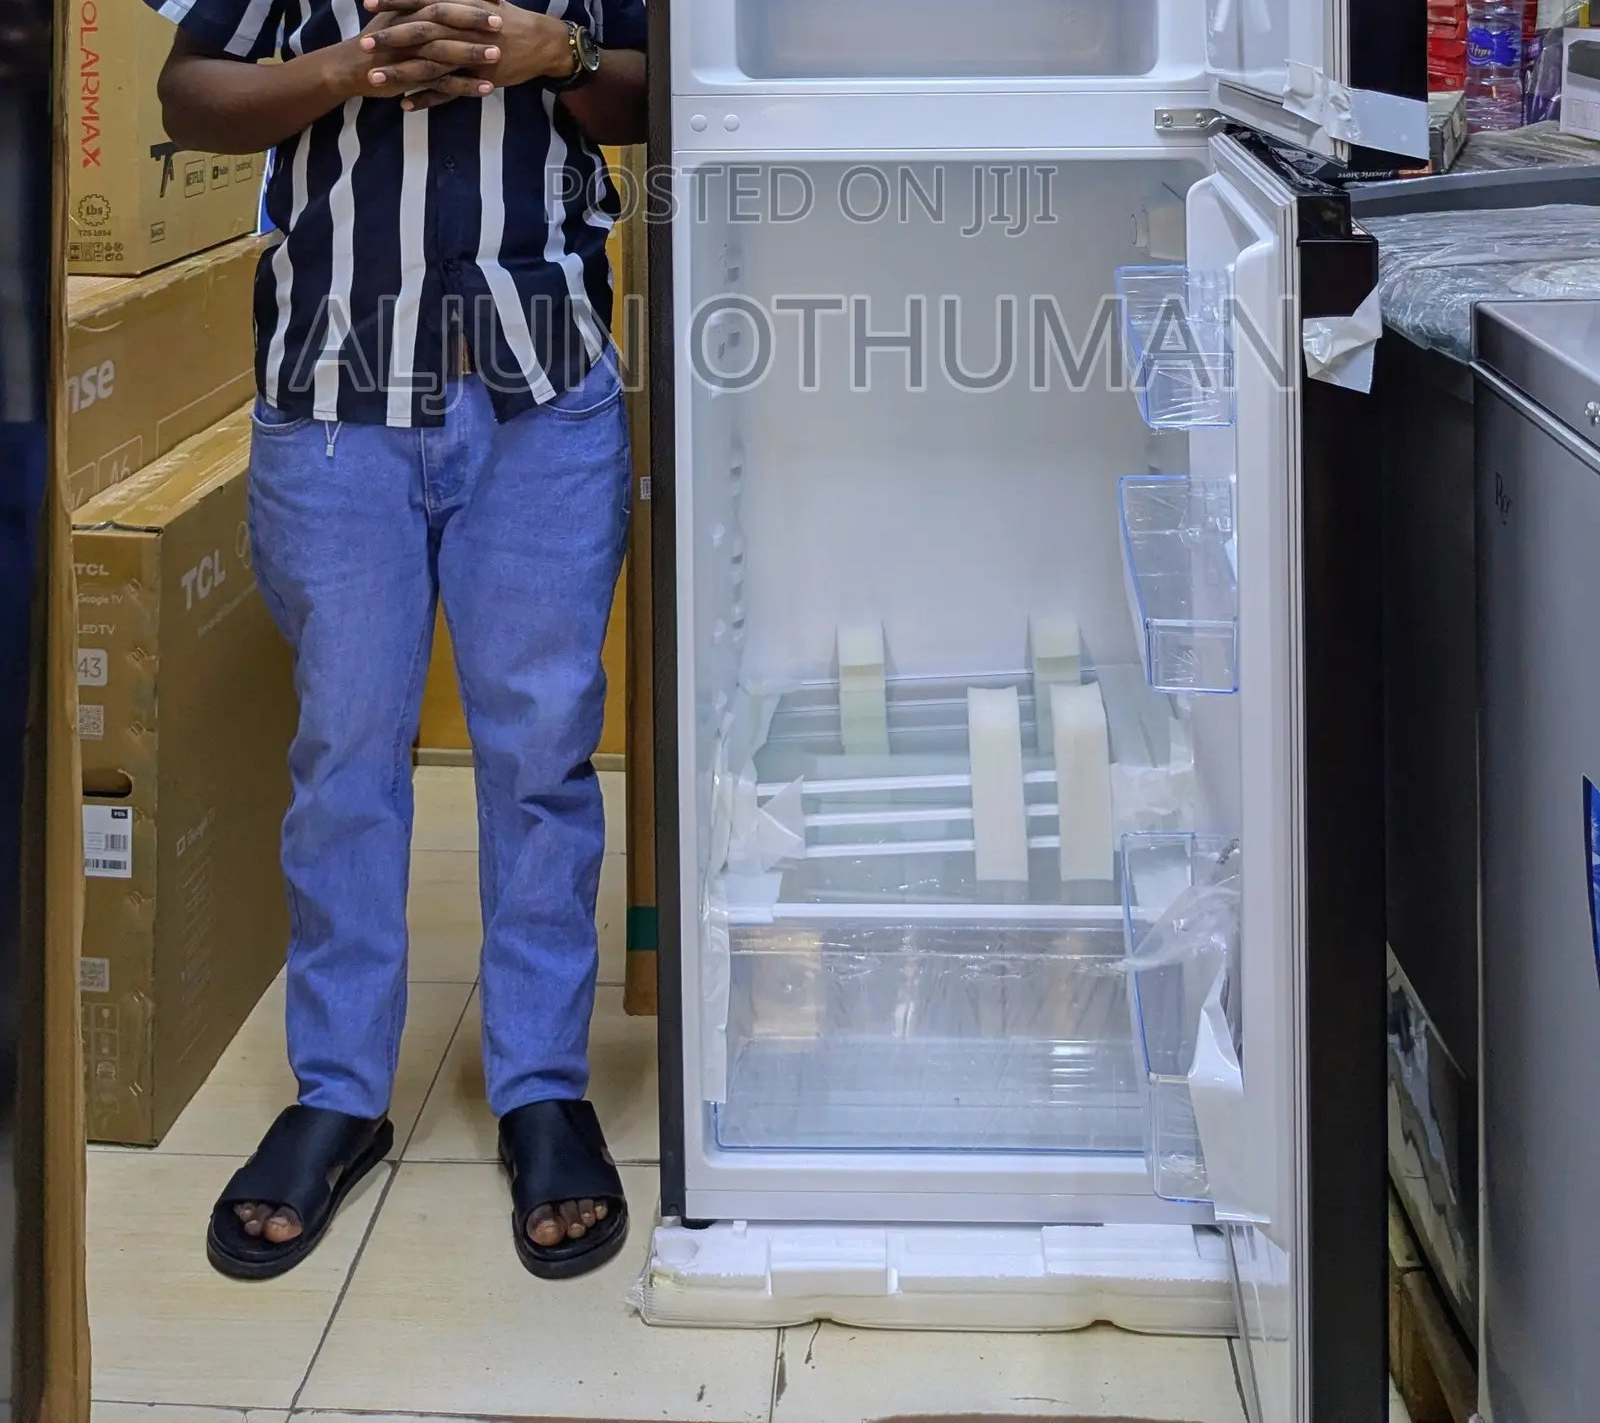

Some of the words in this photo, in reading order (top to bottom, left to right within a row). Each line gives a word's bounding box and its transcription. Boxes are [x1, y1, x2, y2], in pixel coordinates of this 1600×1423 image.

[85, 202, 103, 216] tbs
[75, 563, 110, 576] TCL
[181, 549, 226, 611] TCL
[77, 593, 109, 606] Google
[111, 595, 123, 604] TV
[77, 657, 102, 678] 43
